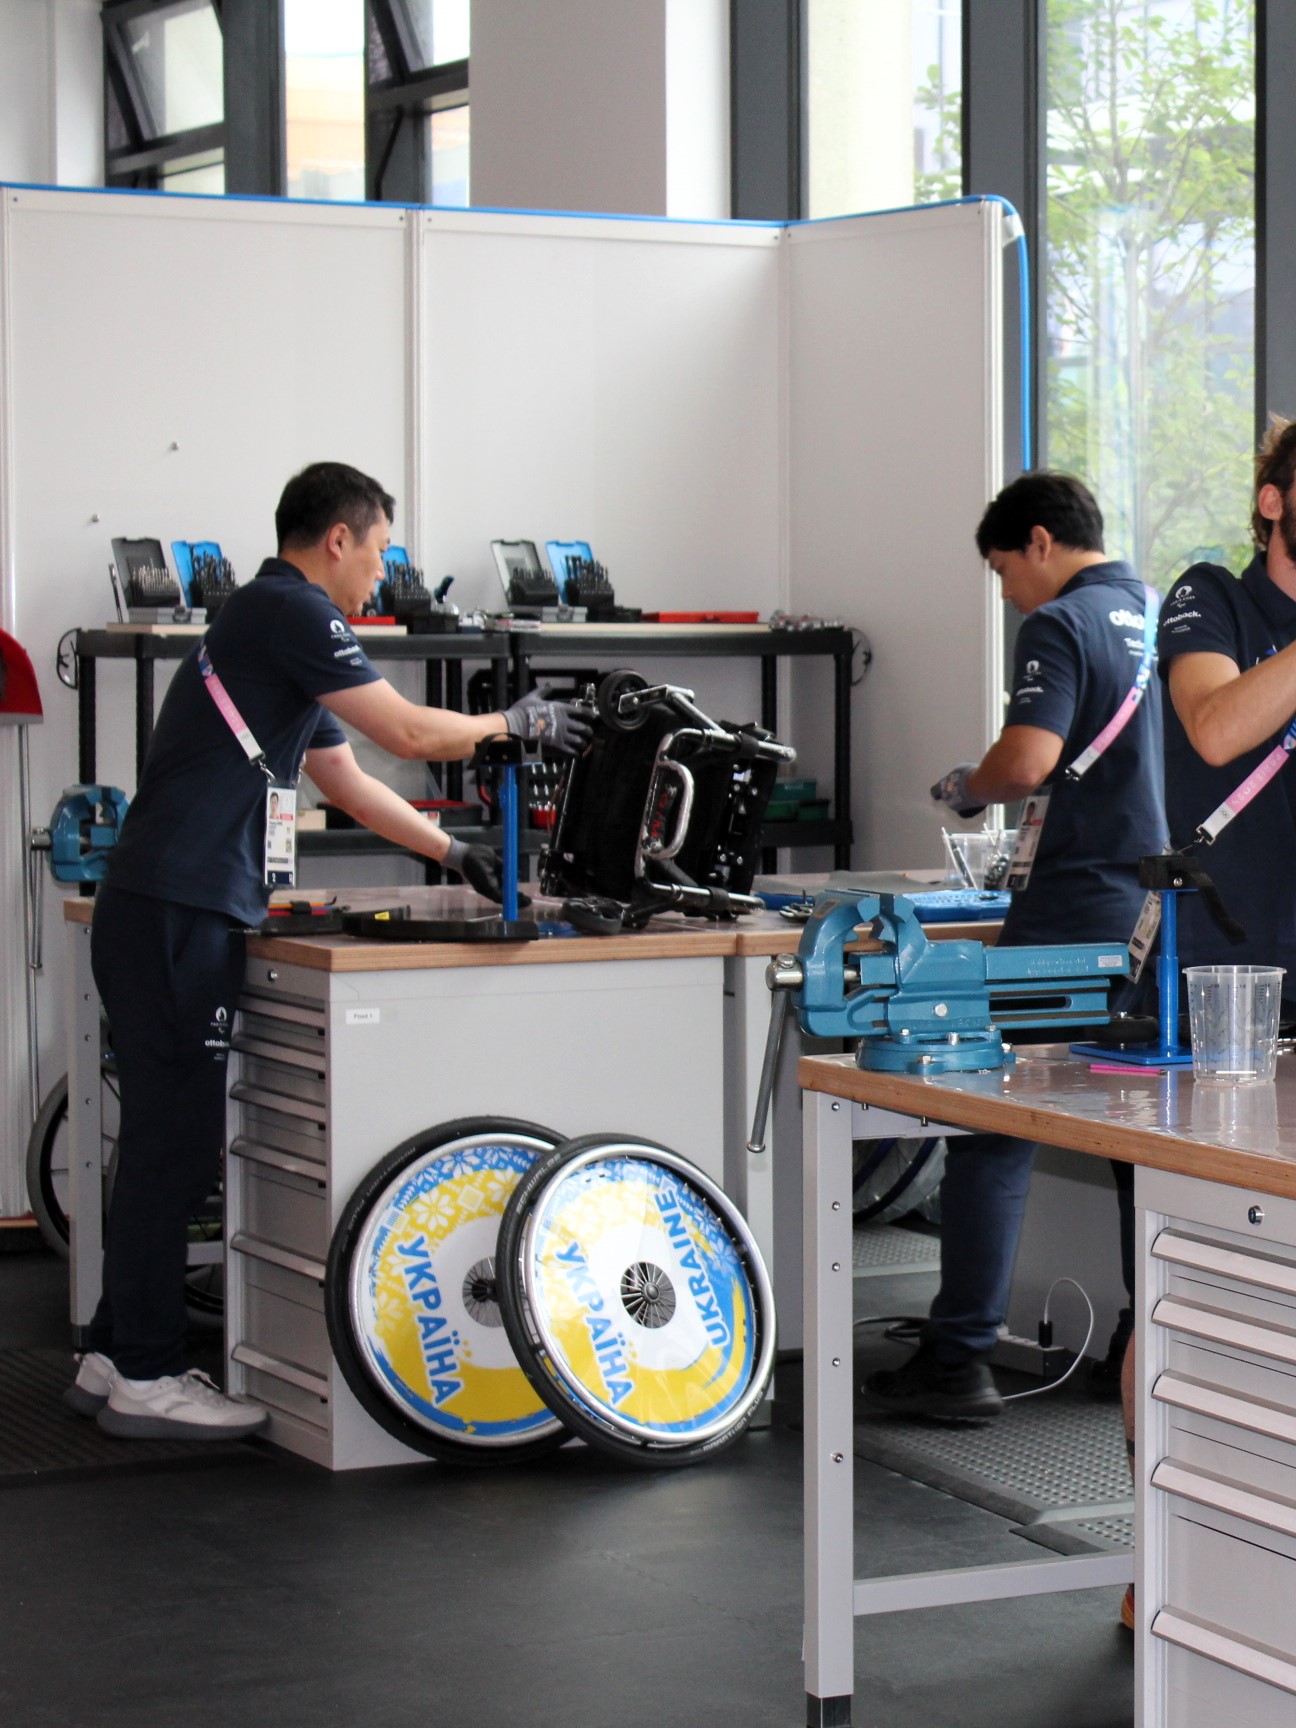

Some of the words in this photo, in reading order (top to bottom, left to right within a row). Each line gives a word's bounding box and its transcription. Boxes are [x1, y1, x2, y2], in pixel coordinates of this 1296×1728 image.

[397, 1235, 462, 1405] УКРАЇНА
[556, 1241, 633, 1406] УКРАЇНА
[654, 1190, 728, 1347] UKRAINE
